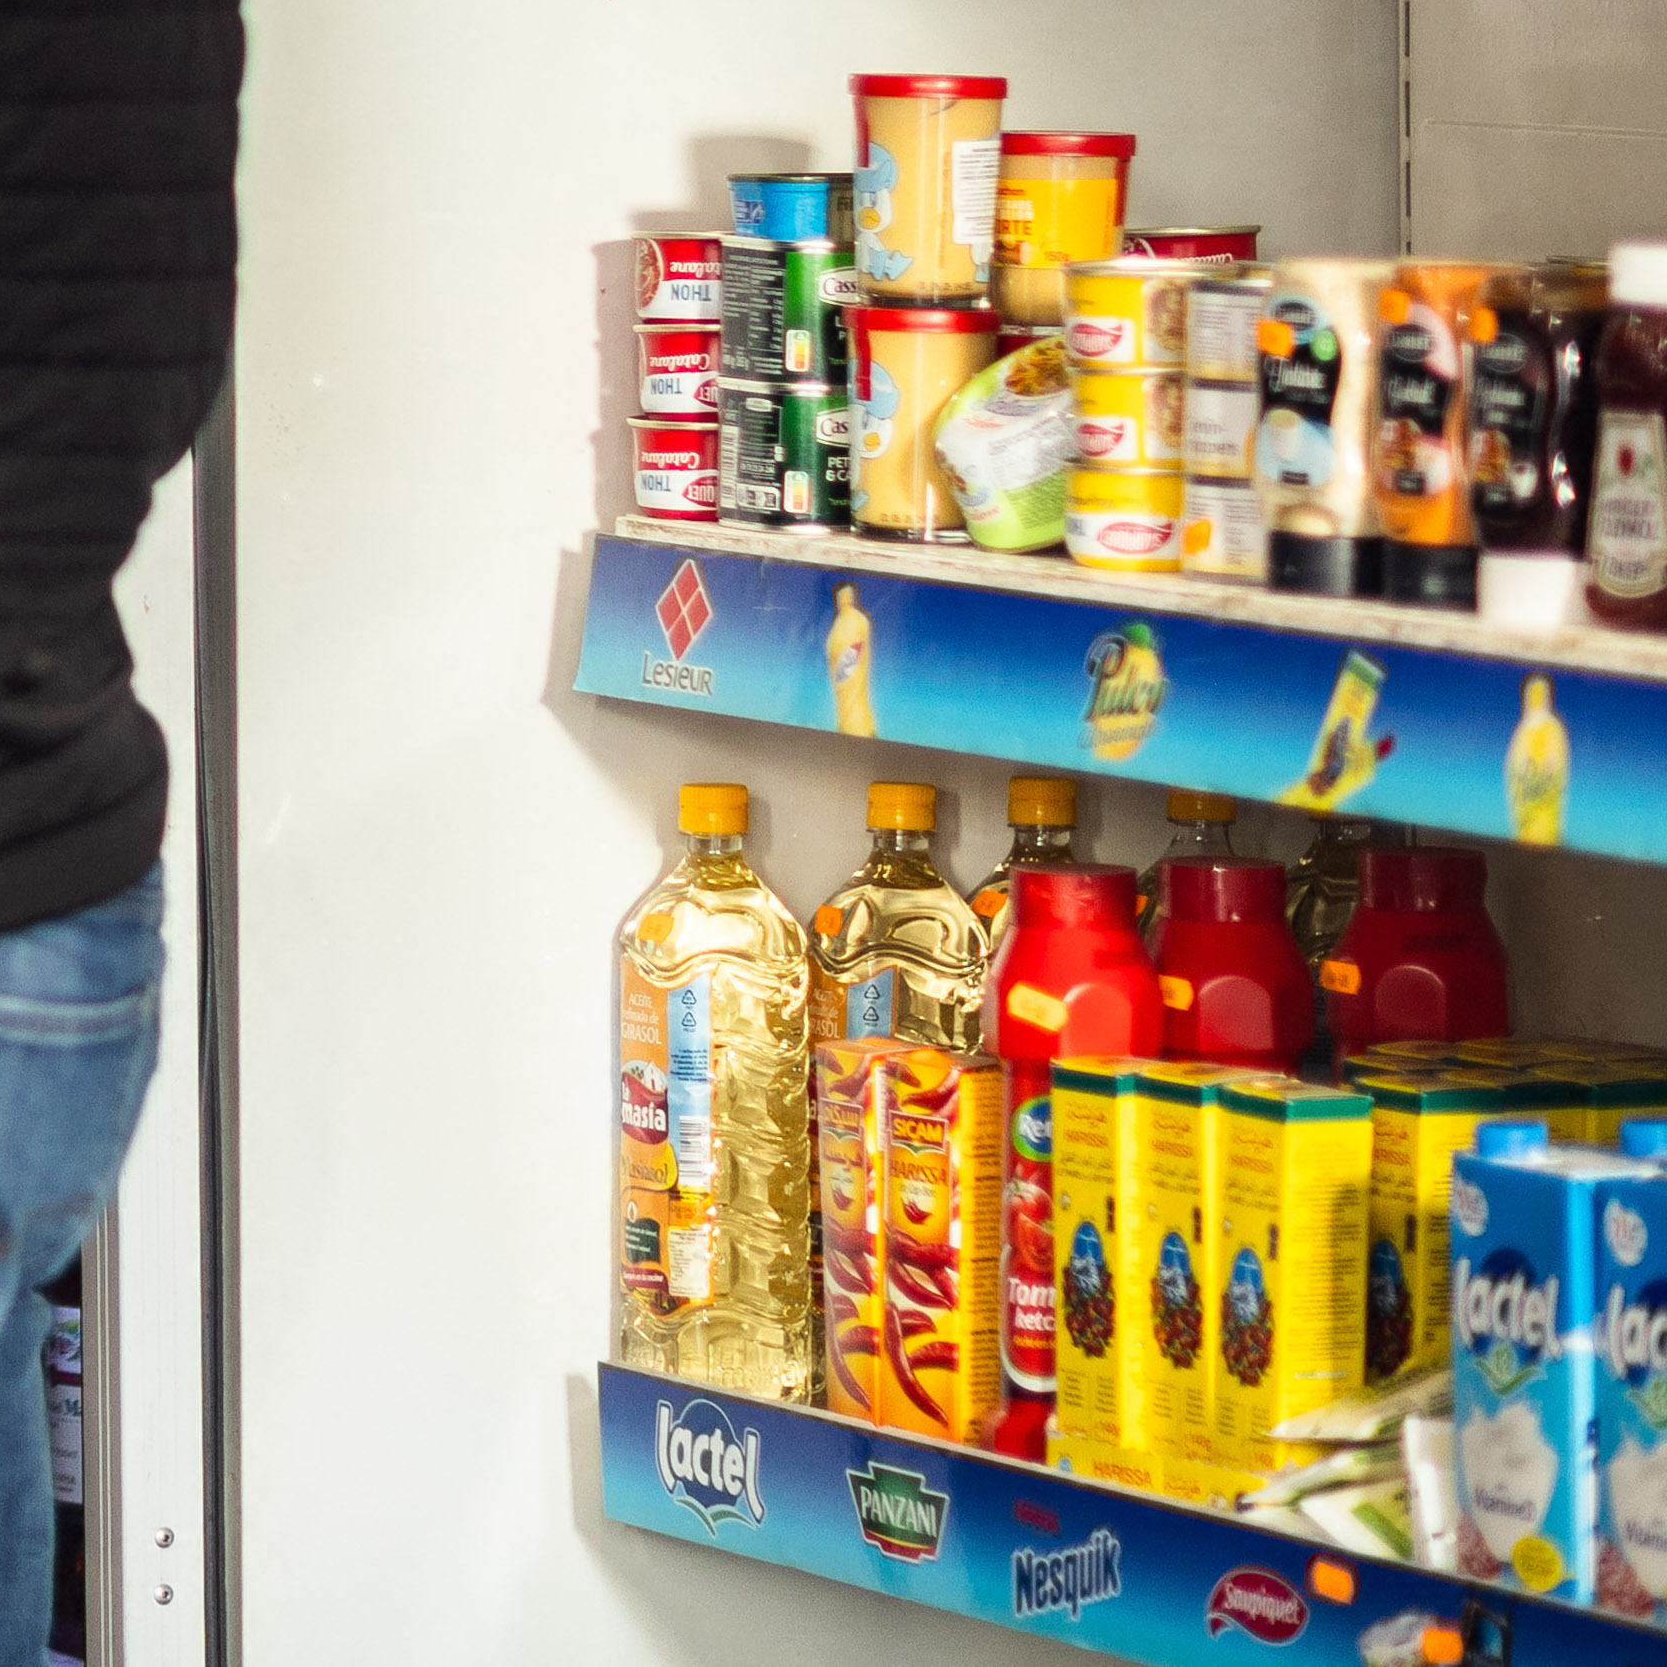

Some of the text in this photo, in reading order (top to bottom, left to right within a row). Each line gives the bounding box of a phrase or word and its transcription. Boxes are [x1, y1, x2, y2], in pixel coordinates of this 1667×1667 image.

[670, 282, 713, 301] THON
[641, 451, 701, 468] Catalane
[893, 1117, 943, 1142] SICAM
[891, 1159, 948, 1186] HARISSA
[657, 1400, 764, 1524] lactel
[861, 1486, 938, 1538] PANZANI
[1013, 1530, 1121, 1620] Nesquik
